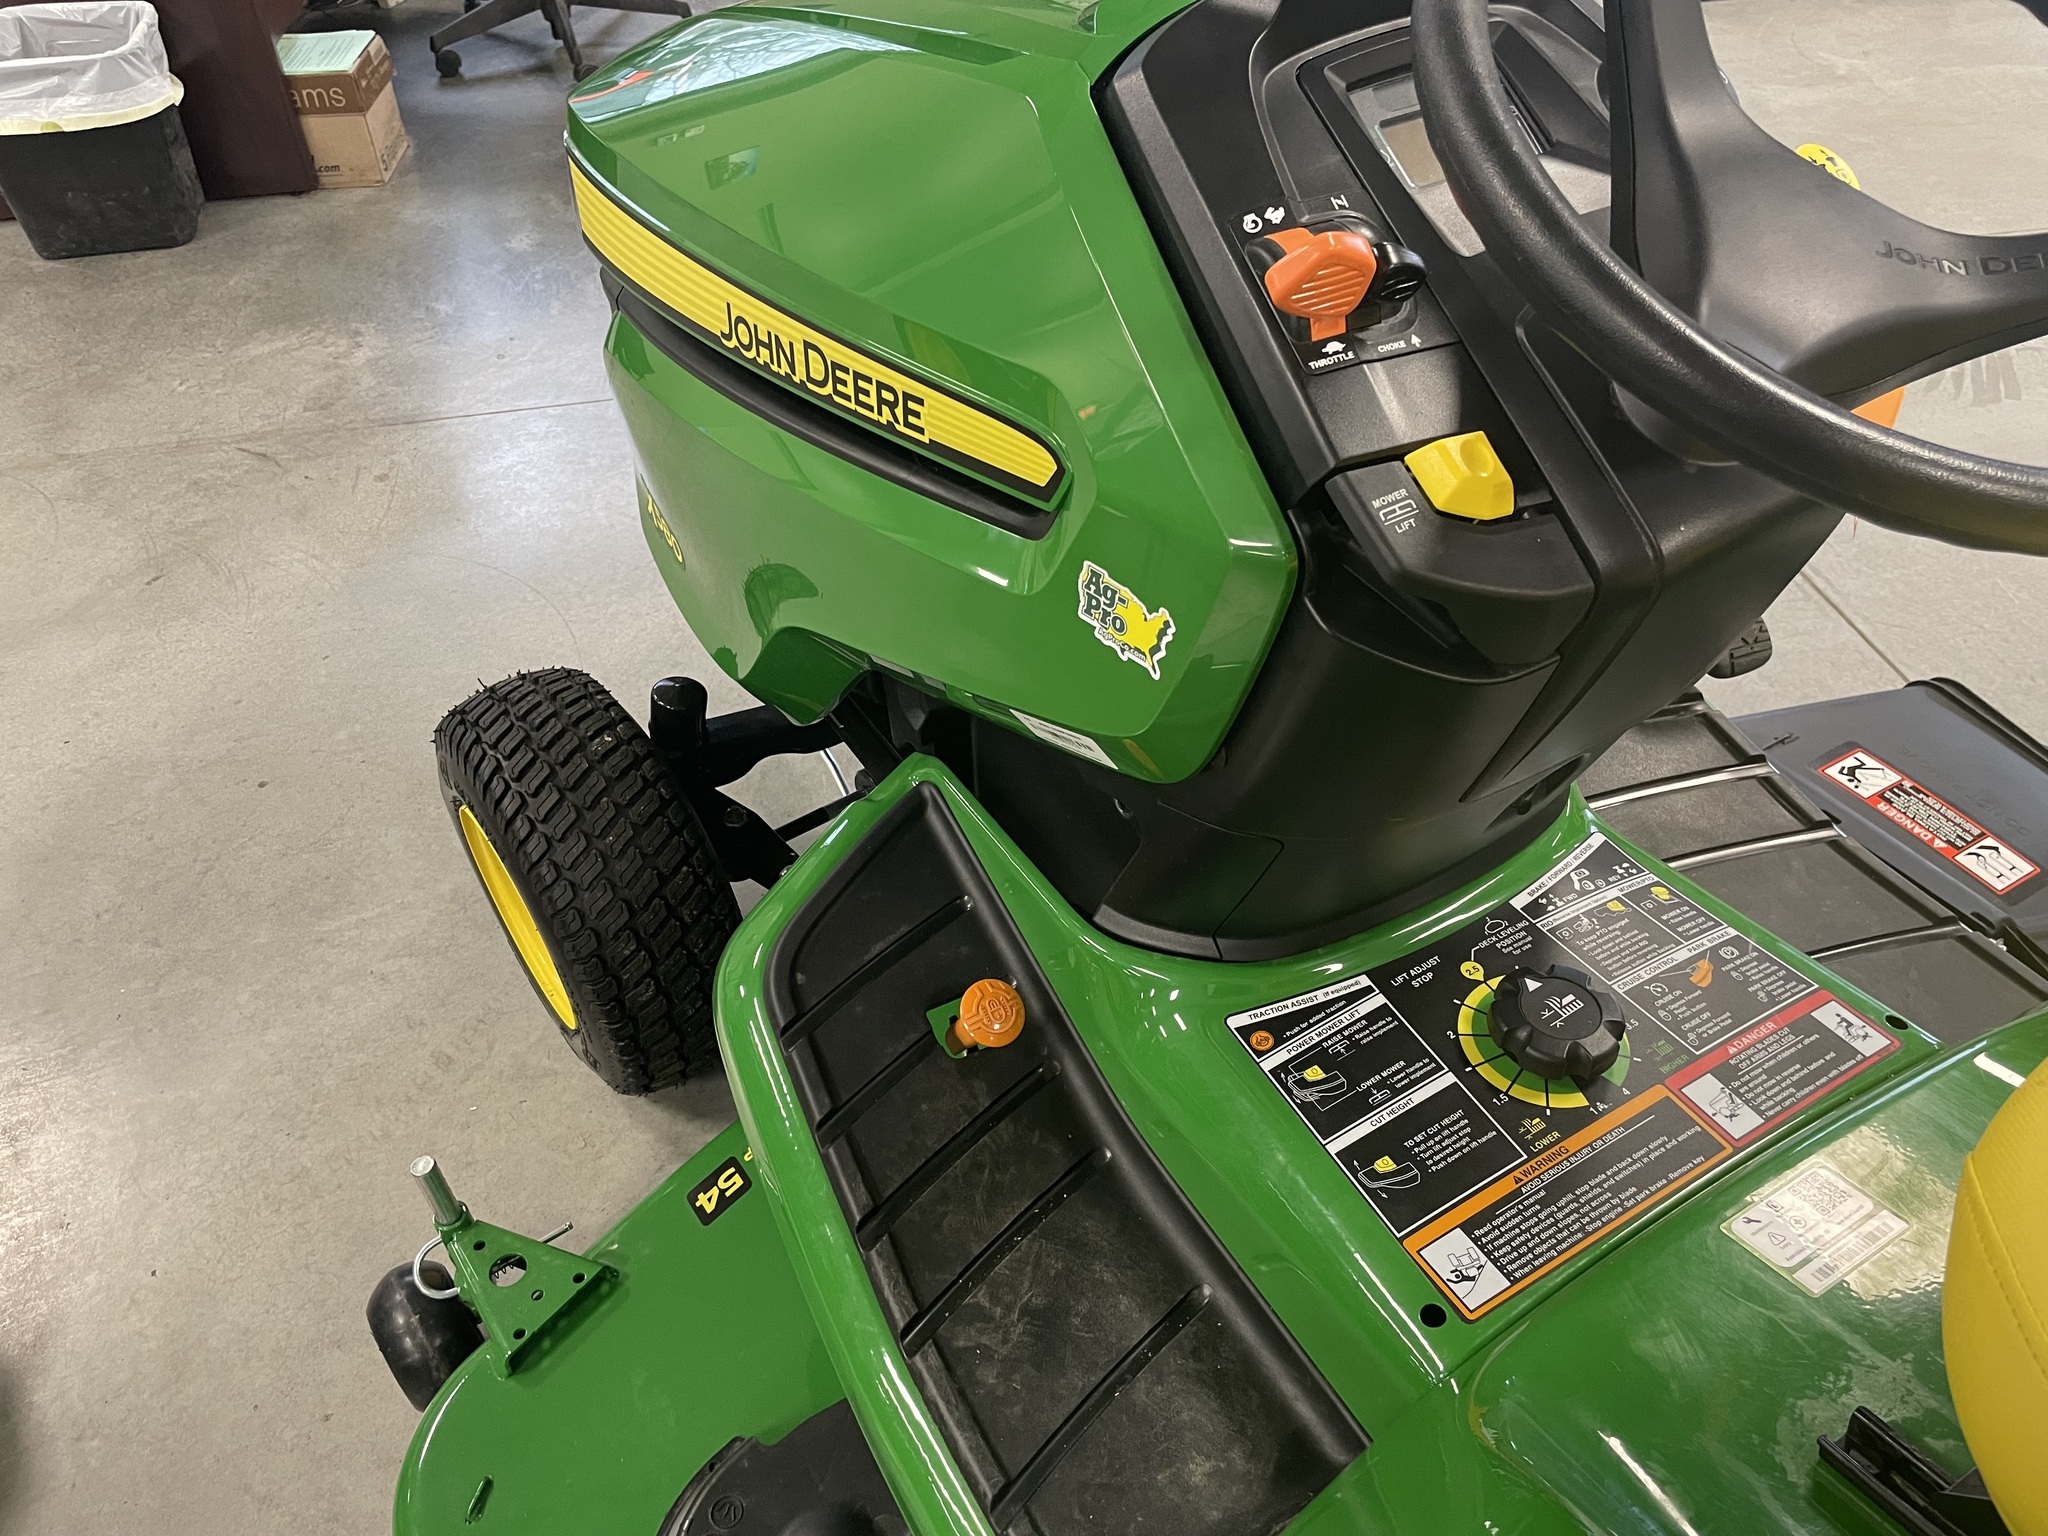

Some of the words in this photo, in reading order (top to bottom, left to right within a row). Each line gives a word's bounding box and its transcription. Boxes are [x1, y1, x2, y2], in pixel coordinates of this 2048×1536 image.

[1875, 241, 1970, 276] JOHN
[1308, 351, 1355, 370] THROTTLE
[1378, 340, 1407, 353] CHOKE
[720, 302, 797, 377] JOHN
[803, 339, 926, 436] DEERE
[1371, 488, 1409, 509] MOWER
[1395, 518, 1416, 533] LIFT
[1084, 568, 1127, 609] Ag-
[1083, 591, 1126, 633] Pro
[1877, 801, 1933, 840] DANGER
[1526, 881, 1548, 897] BRAKE
[1547, 861, 1573, 881] FORWARD
[1572, 842, 1594, 861] REVERSE
[1478, 935, 1499, 948] DECK
[1496, 919, 1530, 939] LEVELING
[1495, 930, 1528, 949] POSITION
[1539, 920, 1554, 930] RIO
[1686, 941, 1708, 954] PARK
[1706, 930, 1731, 944] BRAKE
[1390, 972, 1409, 986] LIFT
[1409, 955, 1441, 977] ADJUST
[1411, 971, 1434, 988] STOP
[1465, 965, 1480, 976] 2.5
[1617, 973, 1645, 990] CRUISE
[1644, 956, 1679, 976] CONTROL
[1248, 1003, 1290, 1020] TRACTION
[1291, 994, 1319, 1008] ASSIST
[1285, 1026, 1301, 1037] Push
[1308, 1011, 1326, 1024] added
[1325, 1000, 1347, 1014] traction
[1286, 1035, 1316, 1055] POWER
[1314, 1018, 1345, 1038] MOWER
[1343, 1008, 1361, 1022] LIFT
[1322, 1033, 1344, 1048] RAISE
[1342, 1019, 1368, 1036] MOWER
[1446, 1030, 1456, 1039] 2
[1728, 1046, 1758, 1066] ROTATING
[1755, 1033, 1780, 1050] BLADES
[1777, 1026, 1790, 1037] CUT
[1733, 1021, 1777, 1049] DANGER
[1659, 1054, 1690, 1074] HIGHER
[1738, 1059, 1751, 1069] OFF
[1750, 1049, 1769, 1062] ARMS
[1766, 1042, 1781, 1053] AND
[1778, 1033, 1796, 1046] LEGS
[1355, 1074, 1382, 1092] LOWER
[1380, 1060, 1406, 1077] MOWER
[1622, 1087, 1631, 1095] 4
[1370, 1113, 1386, 1127] CUT
[1385, 1097, 1415, 1118] HEIGHT
[1492, 1093, 1509, 1106] 1.5
[1403, 1139, 1415, 1148] TO
[1413, 1131, 1428, 1143] SET
[1426, 1123, 1441, 1135] CUT
[1439, 1109, 1464, 1127] HEIGHT
[1413, 1143, 1427, 1154] Pull
[1425, 1139, 1435, 1147] up
[1434, 1134, 1443, 1142] on
[1441, 1129, 1451, 1137] lift
[1448, 1118, 1469, 1132] handle
[1419, 1149, 1434, 1159] Turn
[1432, 1144, 1443, 1152] lift
[1441, 1133, 1460, 1147] adjust
[1458, 1126, 1472, 1137] stop
[1529, 1131, 1561, 1152] LOWER
[1430, 1160, 1448, 1172] Push
[1446, 1151, 1463, 1163] down
[1462, 1146, 1471, 1154] on
[1469, 1141, 1479, 1149] lift
[1476, 1130, 1497, 1144] handle
[1432, 1146, 1454, 1162] desired
[1451, 1136, 1471, 1150] height
[1518, 1145, 1570, 1178] WARNING
[1521, 1177, 1542, 1194] AVOID
[1540, 1160, 1571, 1181] SERIOUS
[1568, 1145, 1593, 1164] INJURY
[1592, 1139, 1605, 1149] OR
[1602, 1126, 1626, 1143] DEATH
[695, 1167, 744, 1214] 54
[1486, 1243, 1494, 1251] If
[1492, 1227, 1521, 1248] machine
[1519, 1216, 1539, 1230] stops
[1537, 1204, 1558, 1220] going
[1574, 1184, 1590, 1195] stop
[1587, 1173, 1607, 1187] blade
[1605, 1165, 1619, 1176] and
[1616, 1157, 1634, 1169] back
[1631, 1146, 1650, 1160] down
[1648, 1135, 1669, 1150] slowly
[1492, 1244, 1512, 1258] Keep
[1510, 1231, 1531, 1247] safety
[1530, 1217, 1555, 1235] devices
[1602, 1177, 1616, 1189] and
[1648, 1146, 1666, 1161] place
[1665, 1138, 1678, 1150] and
[1676, 1125, 1702, 1142] working
[1473, 1222, 1493, 1237] Read
[1522, 1188, 1547, 1207] manual
[1481, 1228, 1501, 1244] Avoid
[1499, 1214, 1524, 1232] sudden
[1522, 1204, 1541, 1218] turns
[1499, 1251, 1519, 1265] Drive
[1517, 1245, 1528, 1254] up
[1527, 1235, 1541, 1248] and
[1539, 1226, 1558, 1240] down
[1579, 1204, 1592, 1214] not
[1590, 1191, 1612, 1207] across
[1506, 1252, 1534, 1272] Remove
[1533, 1237, 1557, 1255] objects
[1555, 1228, 1570, 1240] that
[1568, 1221, 1582, 1232] can
[1579, 1216, 1591, 1224] be
[1588, 1202, 1613, 1219] thrown
[1609, 1197, 1621, 1205] by
[1618, 1186, 1638, 1200] blade
[1512, 1264, 1534, 1278] When
[1531, 1249, 1558, 1267] leaving
[1601, 1206, 1623, 1222] engine
[1635, 1189, 1651, 1202] park
[1648, 1178, 1668, 1192] brake
[1691, 1155, 1706, 1165] key
